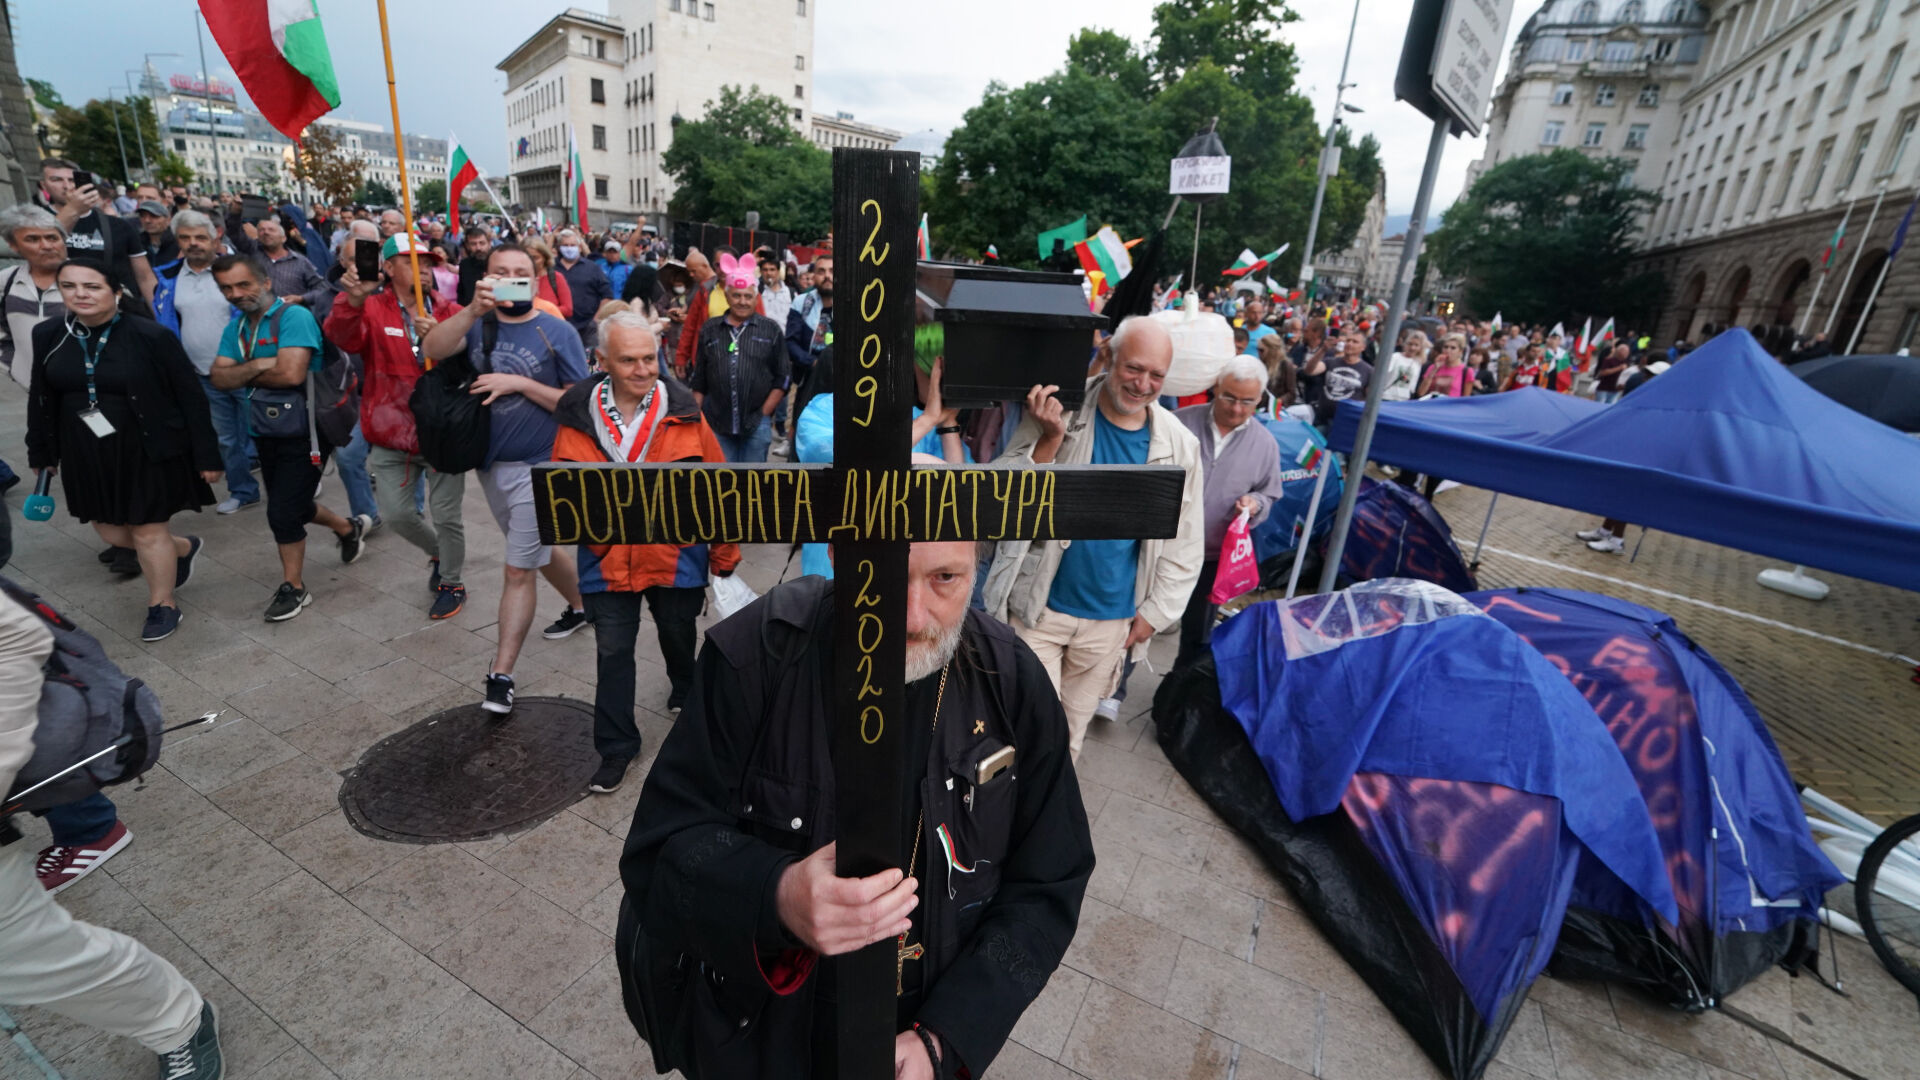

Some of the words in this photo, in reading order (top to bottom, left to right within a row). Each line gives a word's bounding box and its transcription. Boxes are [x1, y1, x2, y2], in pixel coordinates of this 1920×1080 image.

[853, 200, 890, 426] 2009
[547, 469, 815, 542] БОРИСОВАТА
[828, 469, 1055, 540] ДИКТАТУРА
[855, 560, 883, 743] 2020
